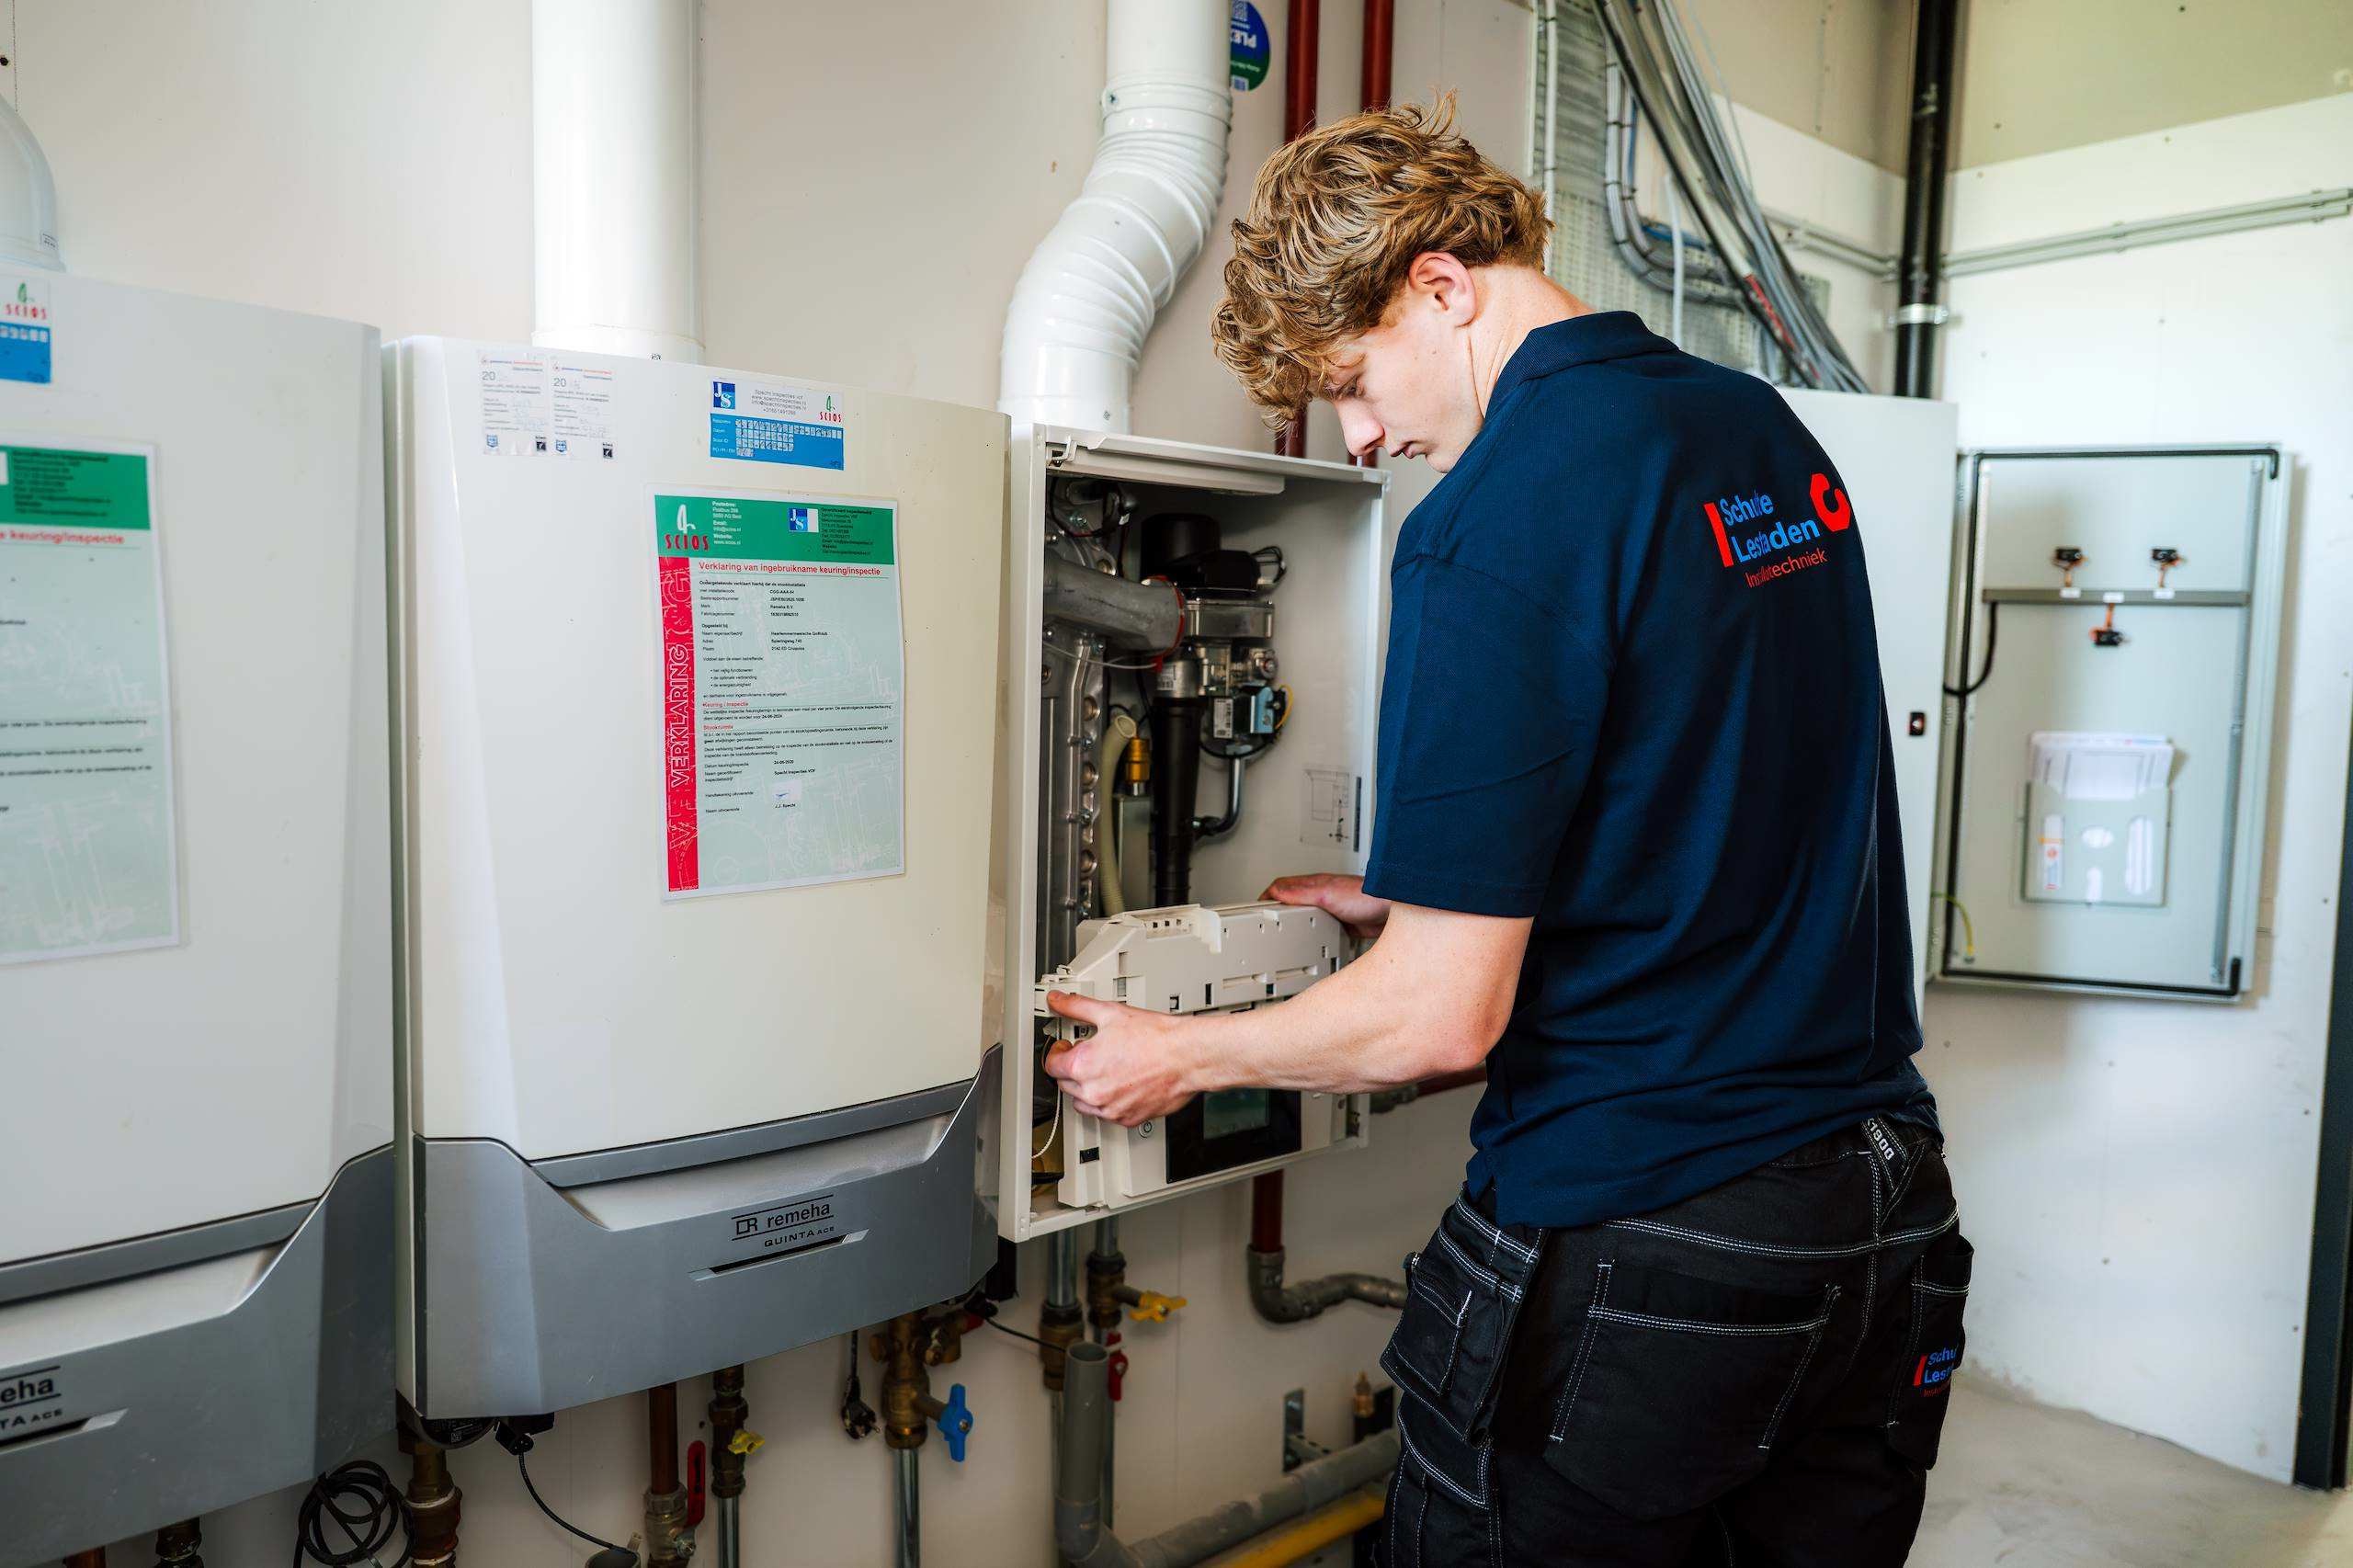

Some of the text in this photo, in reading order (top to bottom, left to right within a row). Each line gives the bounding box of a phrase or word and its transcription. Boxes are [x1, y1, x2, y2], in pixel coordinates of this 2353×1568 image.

[5, 303, 47, 320] SCIOS
[820, 411, 842, 423] SCIOS
[665, 534, 710, 551] SCIOS
[699, 561, 742, 572] Verklaring
[760, 563, 818, 574] ingebruikname
[819, 564, 881, 576] keuring/inspectie
[669, 643, 690, 789] VERKLARING
[767, 1202, 830, 1228] remeha
[764, 1226, 835, 1247] QUINTA ACE
[31, 1408, 63, 1422] ACE
